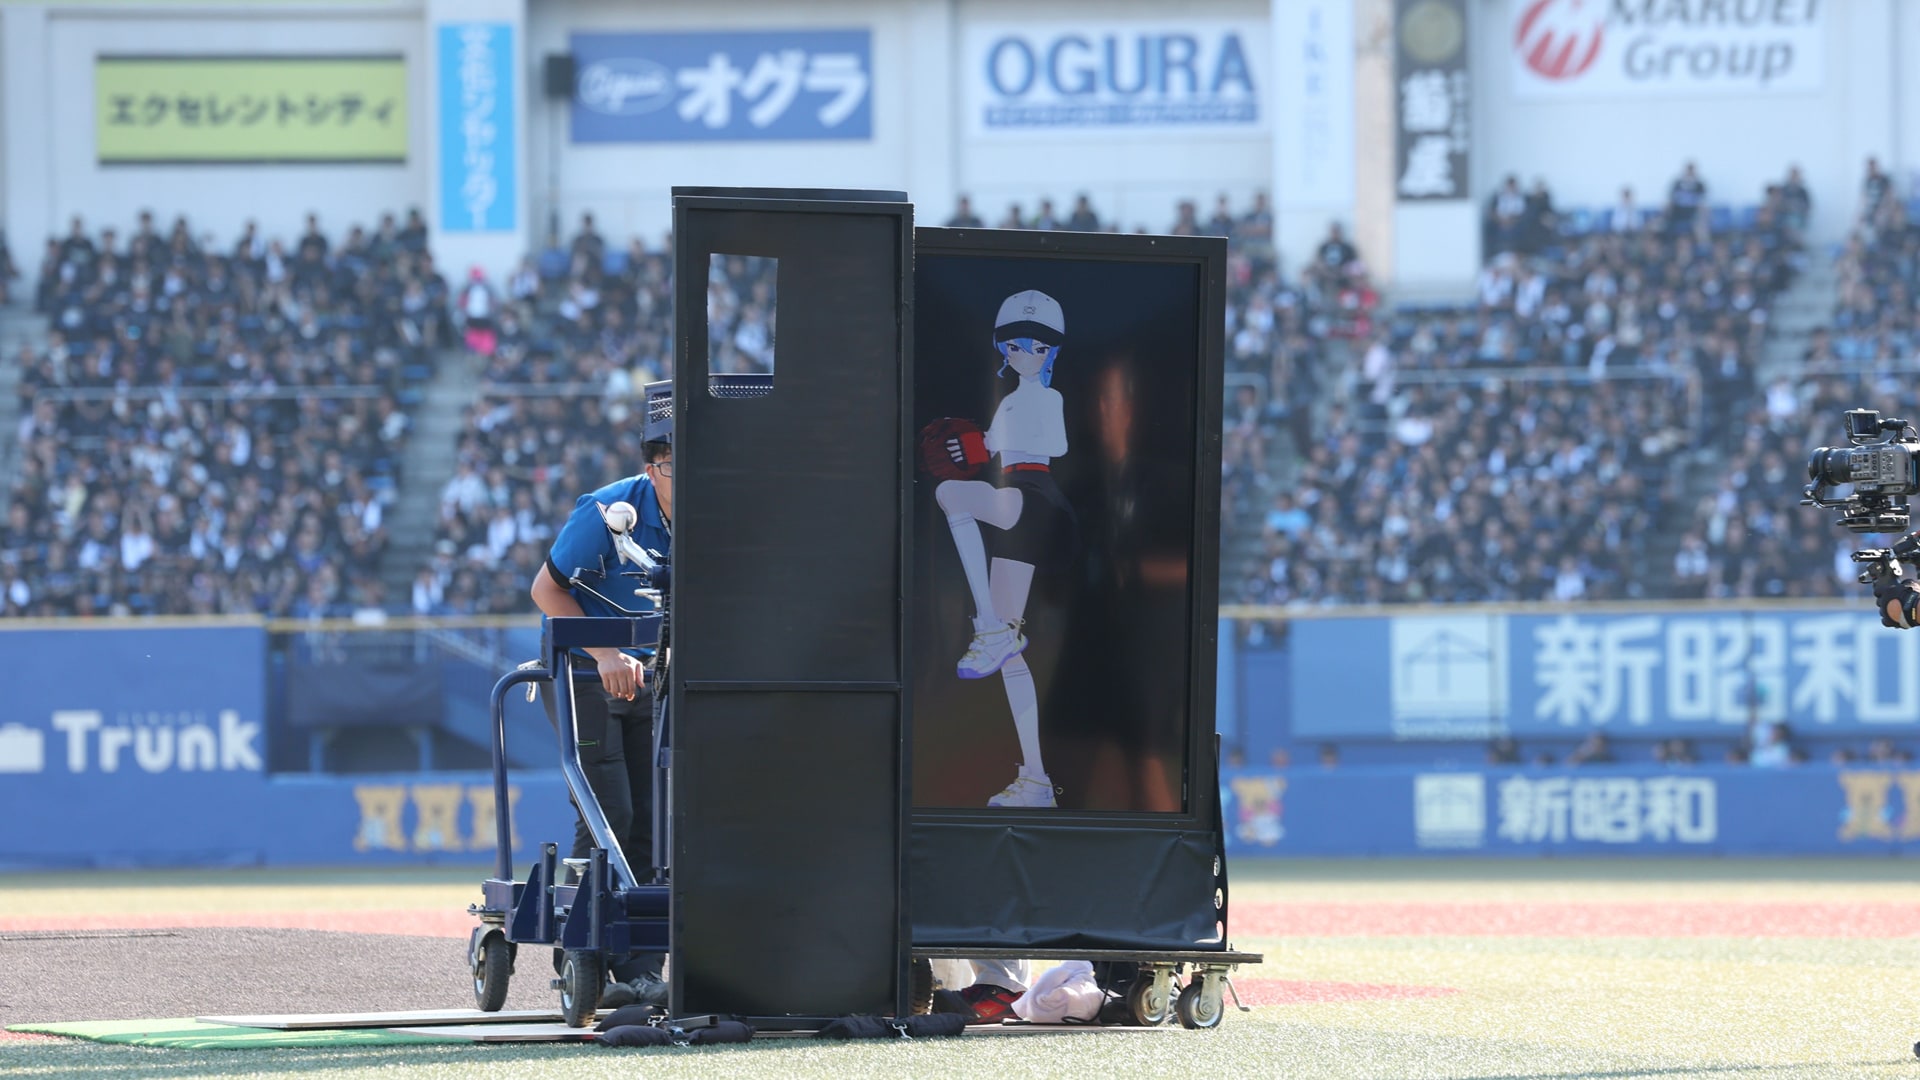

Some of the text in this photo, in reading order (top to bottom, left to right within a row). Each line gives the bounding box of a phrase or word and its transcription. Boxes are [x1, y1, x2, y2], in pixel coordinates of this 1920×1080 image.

[677, 51, 870, 128] オグラ
[985, 33, 1255, 97] OGURA
[1624, 35, 1795, 85] Group
[108, 92, 397, 127] エクセレントシティ
[1532, 615, 1920, 725] 新昭和
[52, 709, 264, 773] Trunk
[1498, 776, 1717, 843] 新昭和
